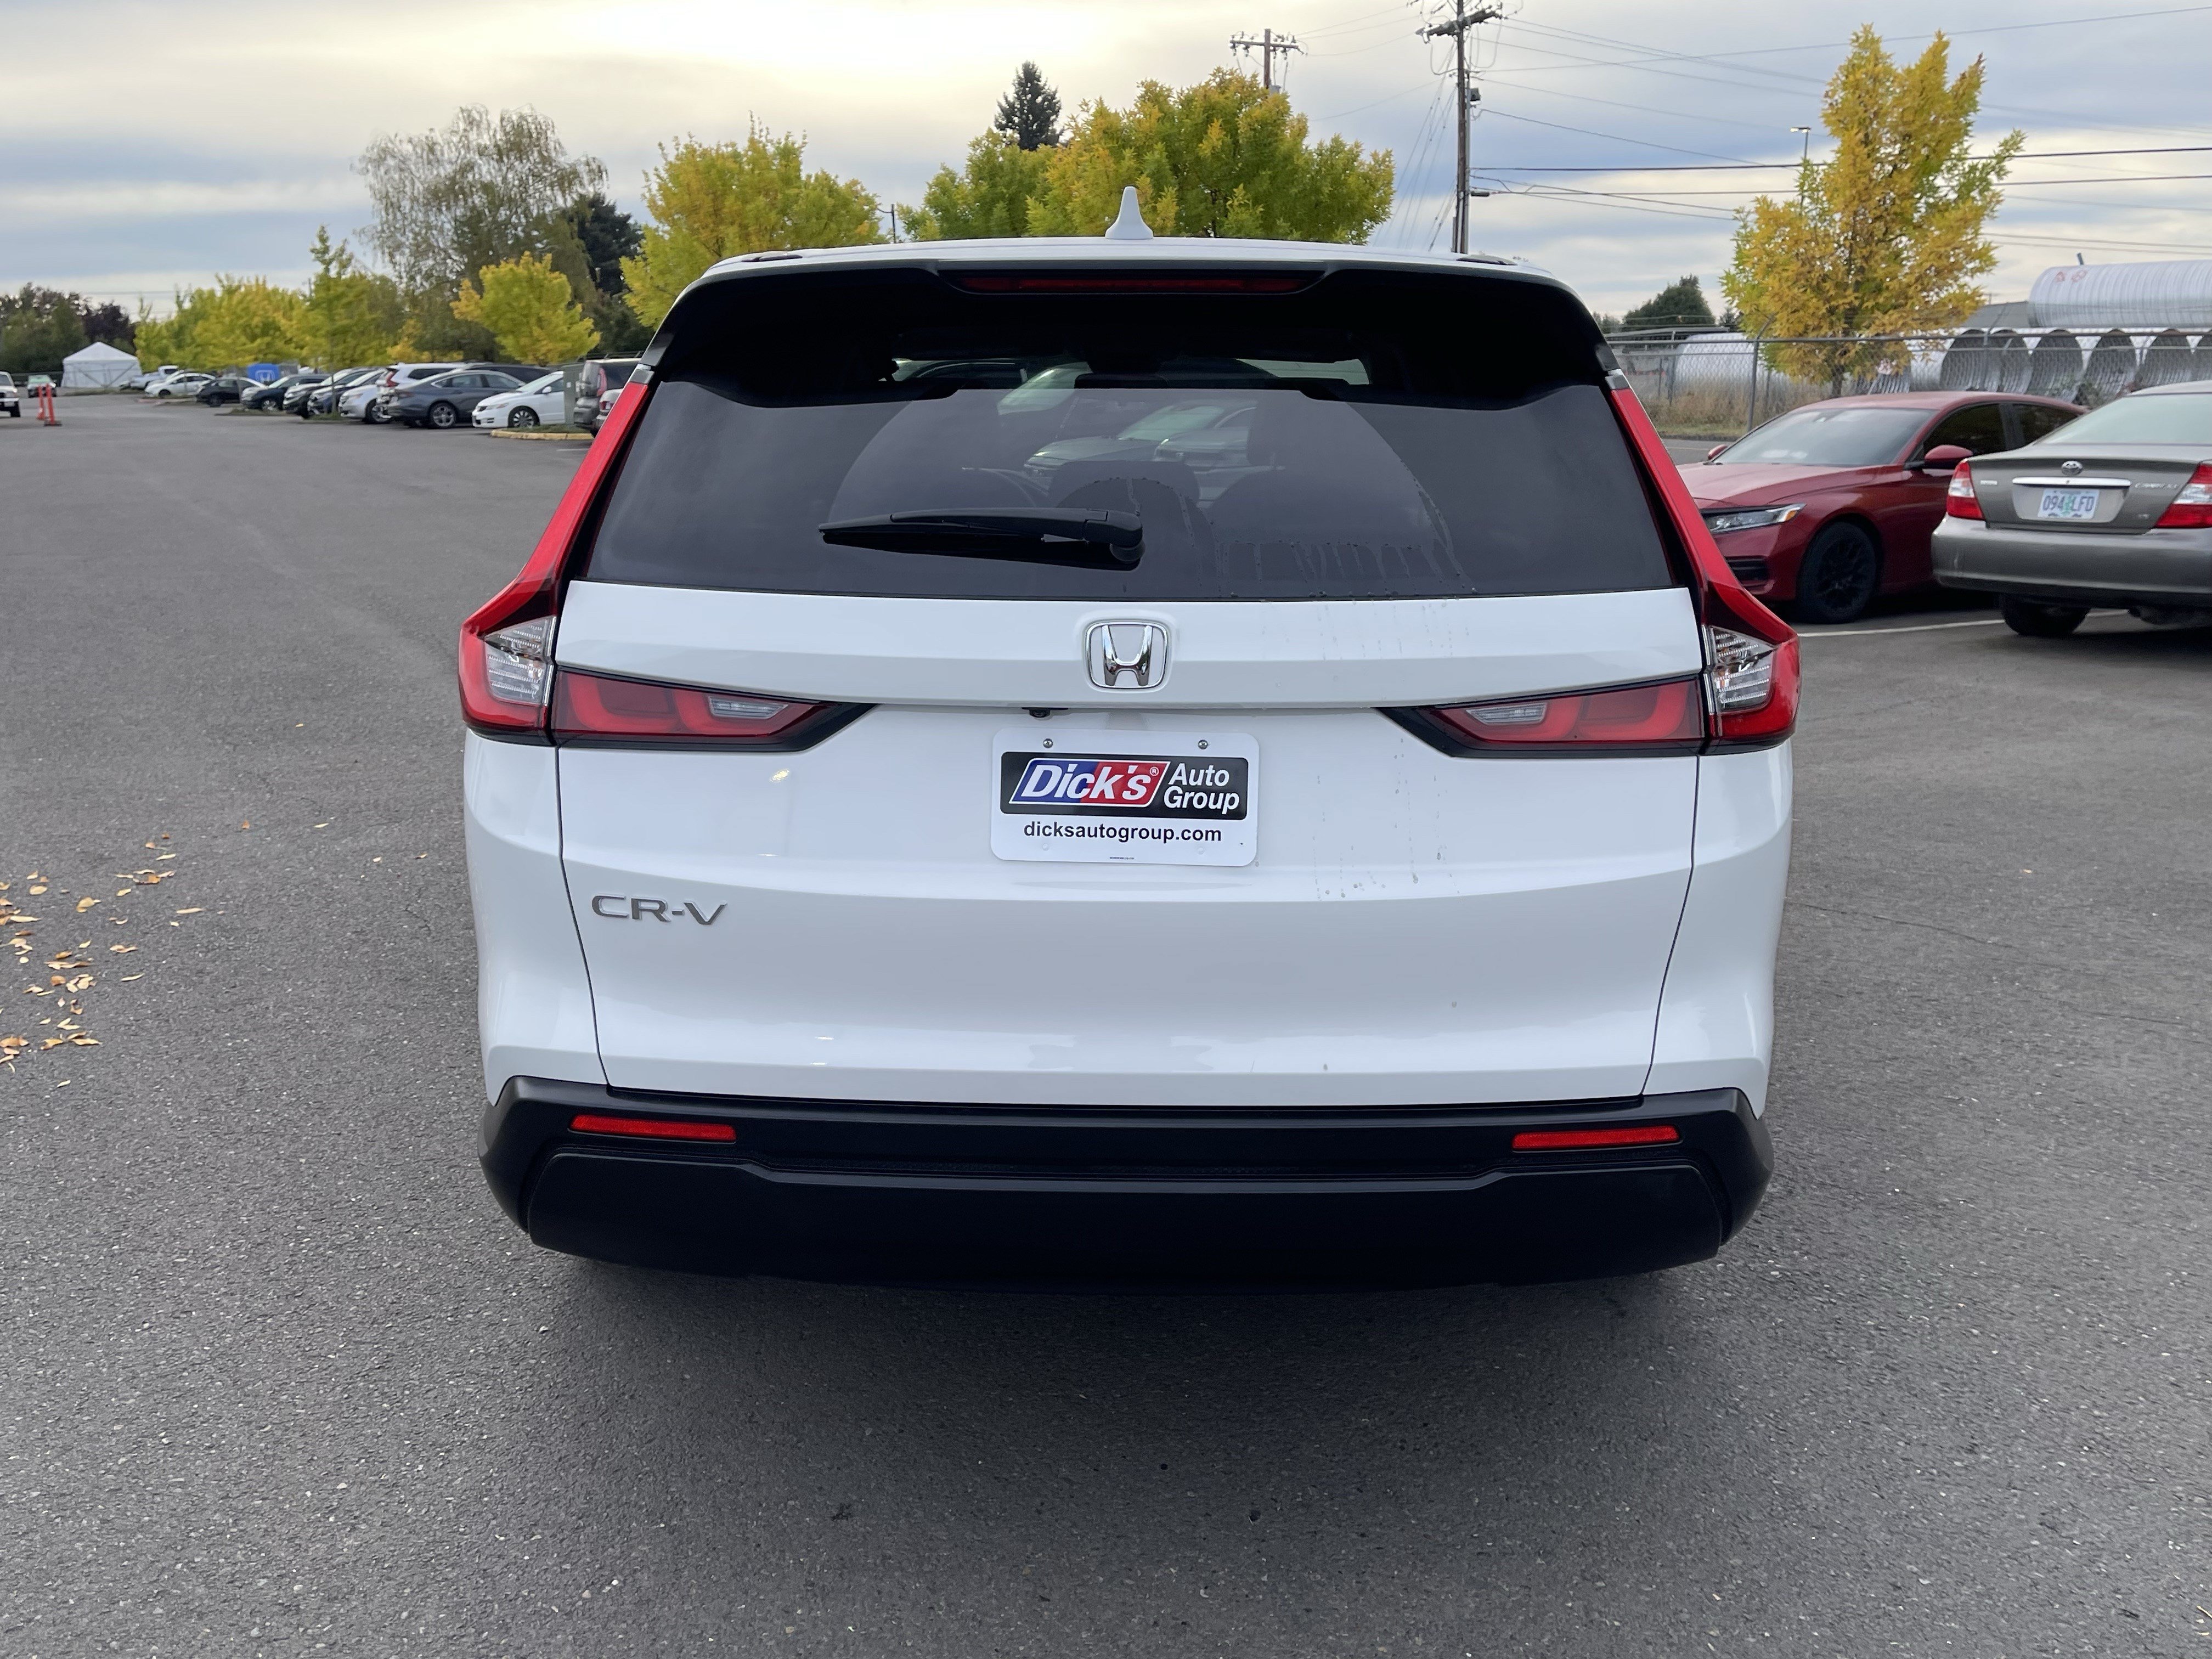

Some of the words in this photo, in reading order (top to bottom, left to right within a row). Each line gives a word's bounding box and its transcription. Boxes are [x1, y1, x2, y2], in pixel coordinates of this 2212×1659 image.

[2043, 495, 2064, 510] 094
[1168, 763, 1229, 787] Auto
[1164, 786, 1240, 814] Group
[1024, 821, 1222, 844] dicksautogroup.com
[591, 894, 727, 926] CR-V
